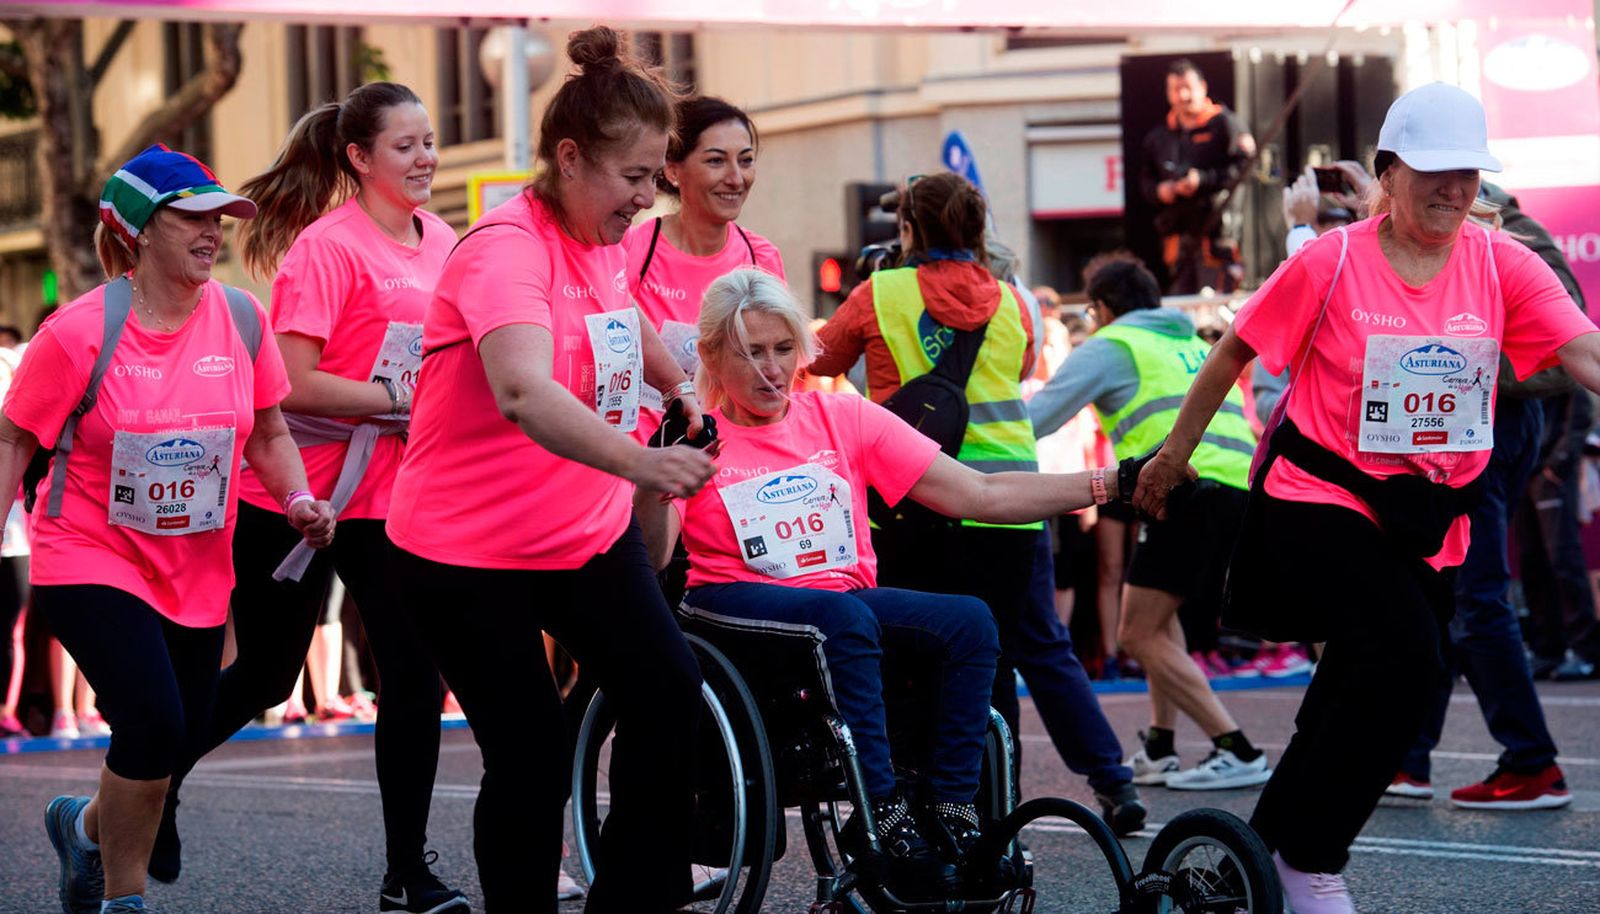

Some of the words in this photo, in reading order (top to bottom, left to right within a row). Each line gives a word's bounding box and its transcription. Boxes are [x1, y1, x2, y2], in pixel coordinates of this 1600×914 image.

[1351, 308, 1406, 329] OYSHO
[1405, 356, 1461, 370] ASTURIANA
[115, 364, 162, 381] OYSHO
[609, 369, 632, 394] 016
[1403, 392, 1457, 414] 016
[1410, 417, 1445, 428] 27556
[1366, 434, 1401, 443] OYSHO
[151, 449, 201, 462] ASTURIANA
[720, 466, 769, 477] OYSHO
[148, 479, 196, 501] 016
[763, 481, 814, 500] ASTURIANA
[155, 503, 187, 514] 26028
[116, 511, 146, 523] OYSHO
[774, 512, 824, 540] 016
[799, 539, 812, 550] 69
